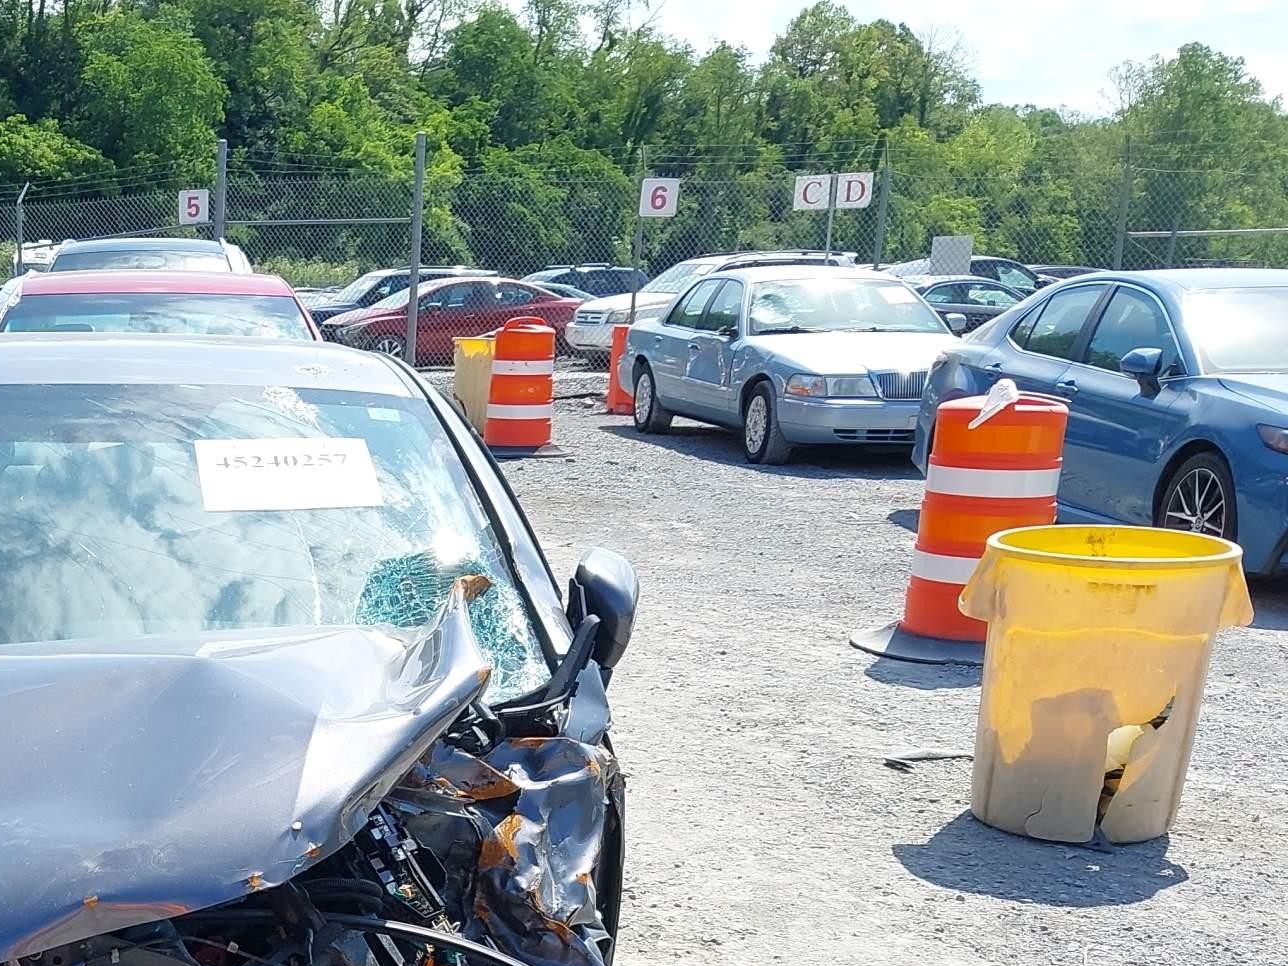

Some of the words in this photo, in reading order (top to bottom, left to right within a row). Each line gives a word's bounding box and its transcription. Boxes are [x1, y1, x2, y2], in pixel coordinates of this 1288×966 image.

[650, 185, 668, 210] 6
[802, 181, 822, 204] C
[843, 179, 866, 203] D
[186, 196, 200, 218] 5
[216, 453, 347, 469] 45240257
